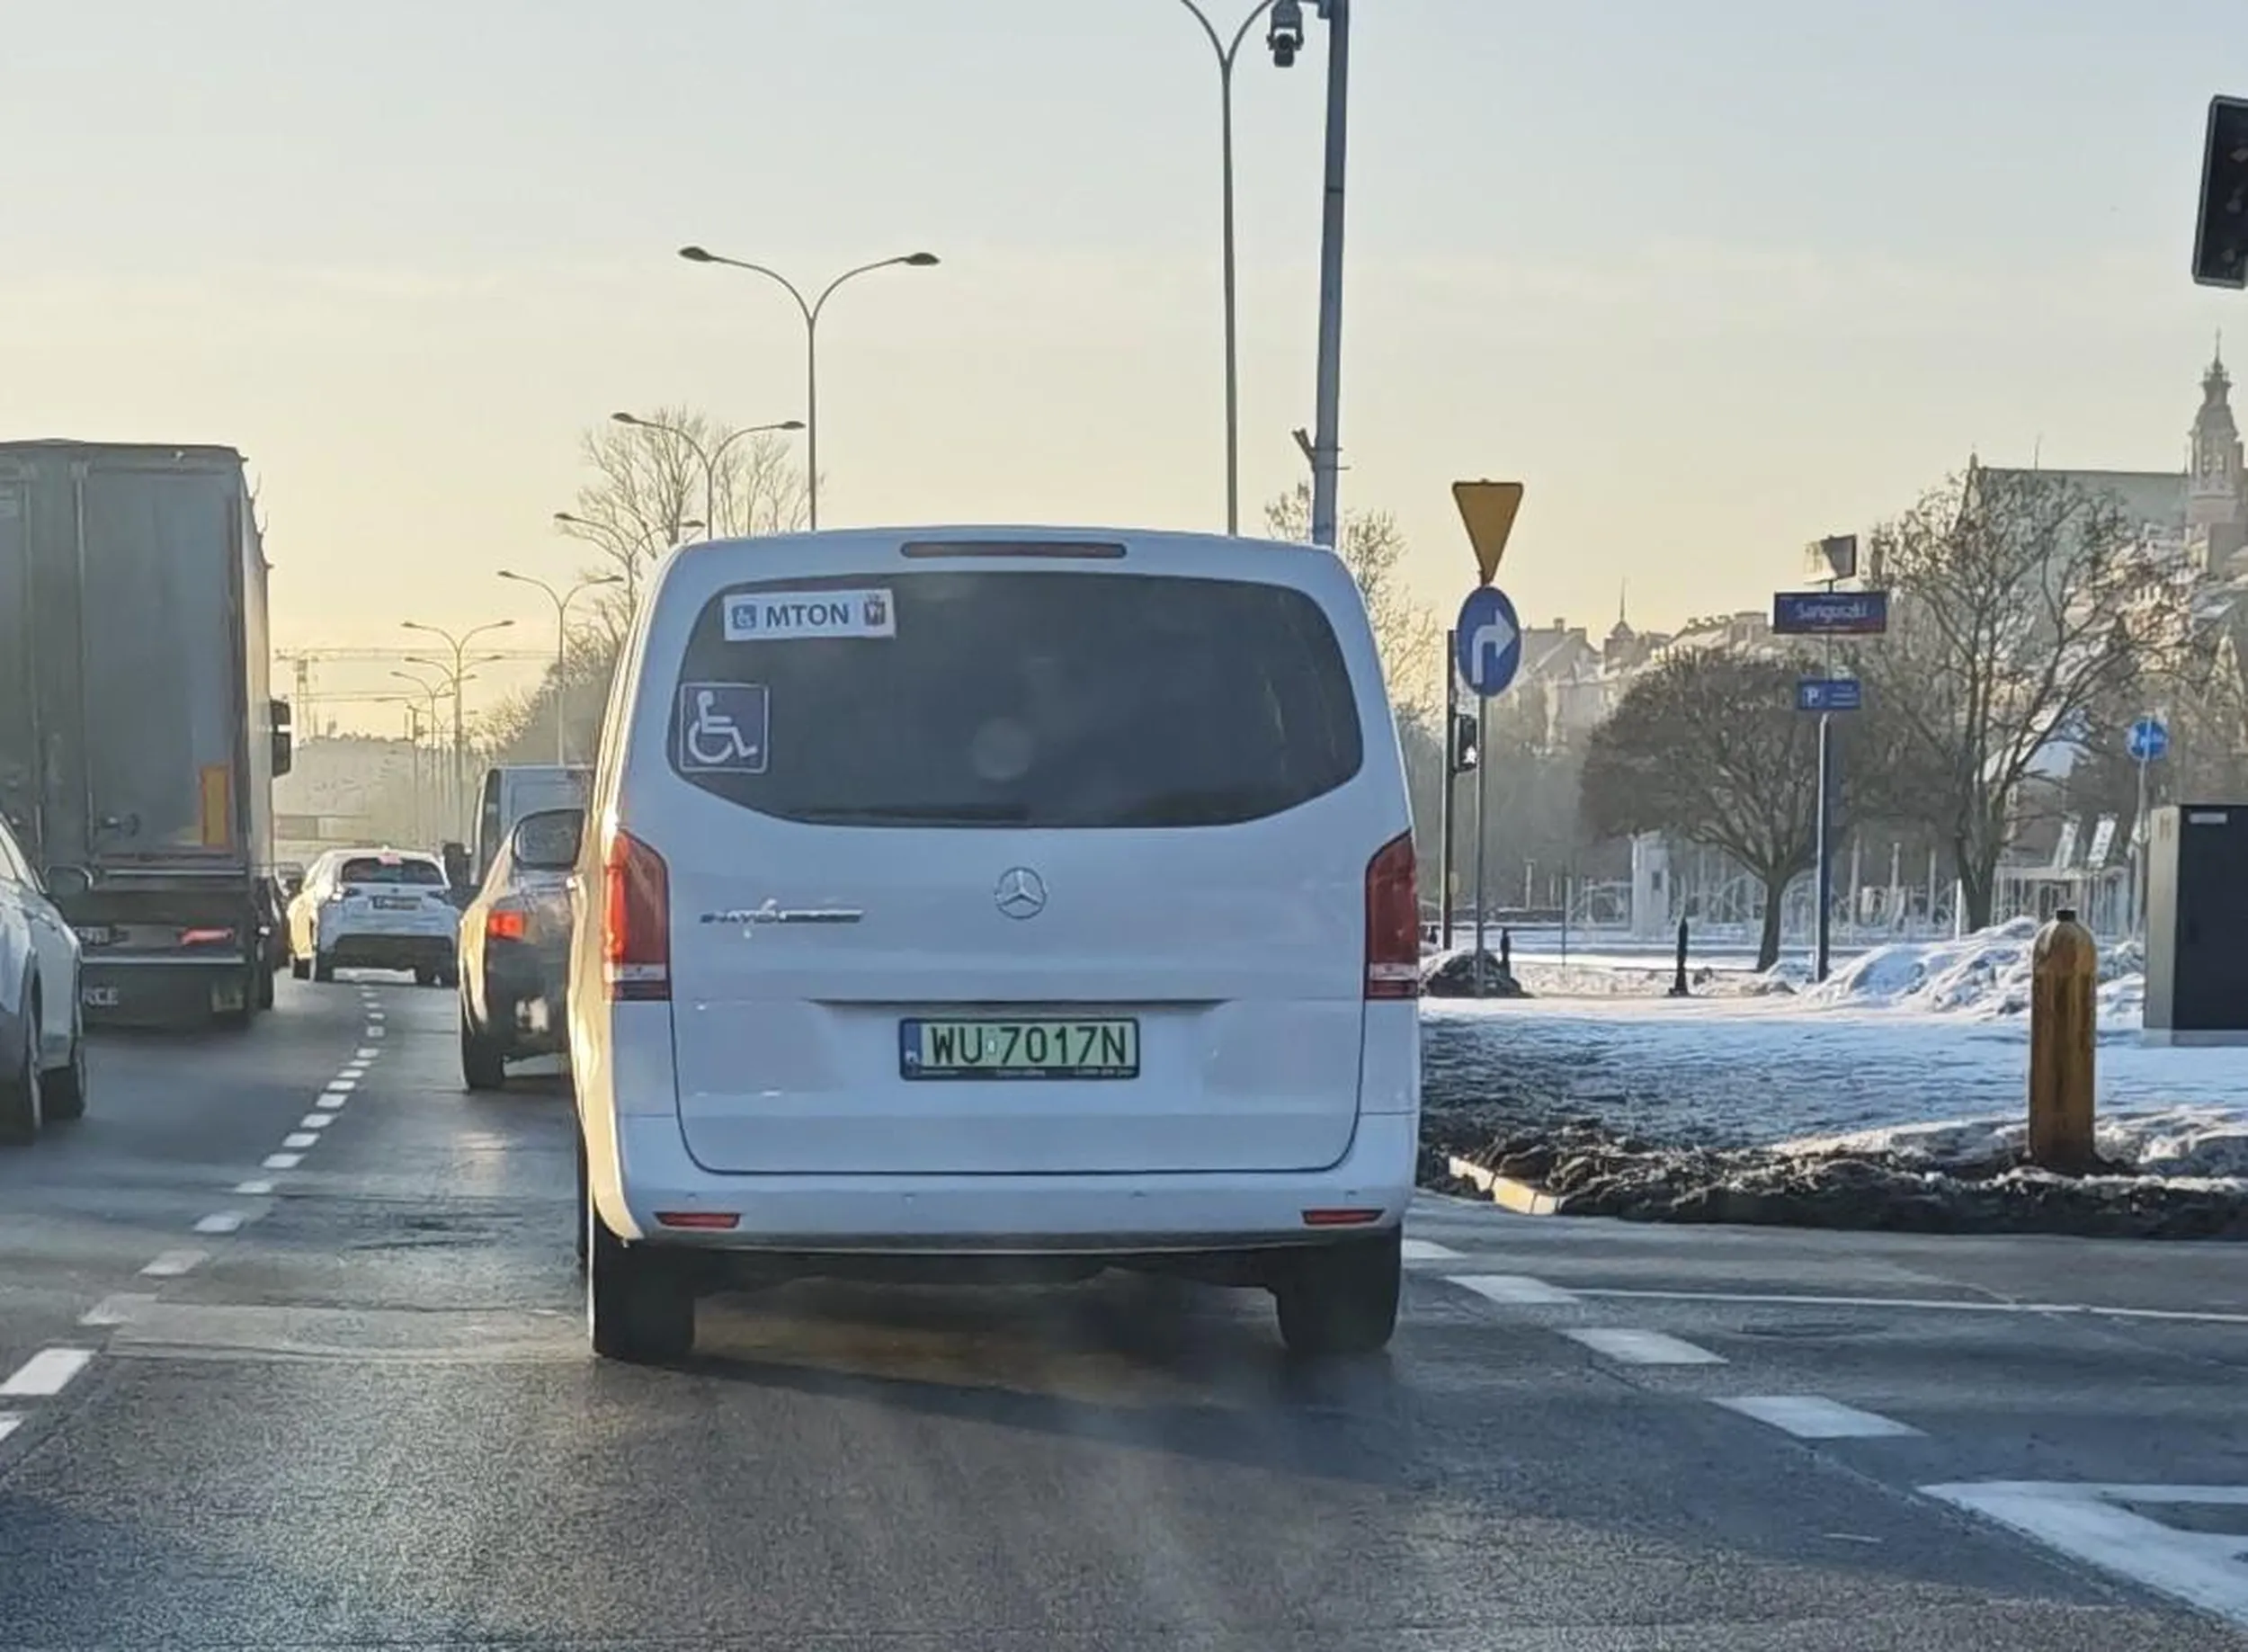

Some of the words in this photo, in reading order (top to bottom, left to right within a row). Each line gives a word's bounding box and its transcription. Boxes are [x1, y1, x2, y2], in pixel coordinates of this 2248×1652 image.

[767, 603, 848, 627] MTON
[932, 1026, 982, 1063] WU
[1000, 1026, 1125, 1063] 7017N
